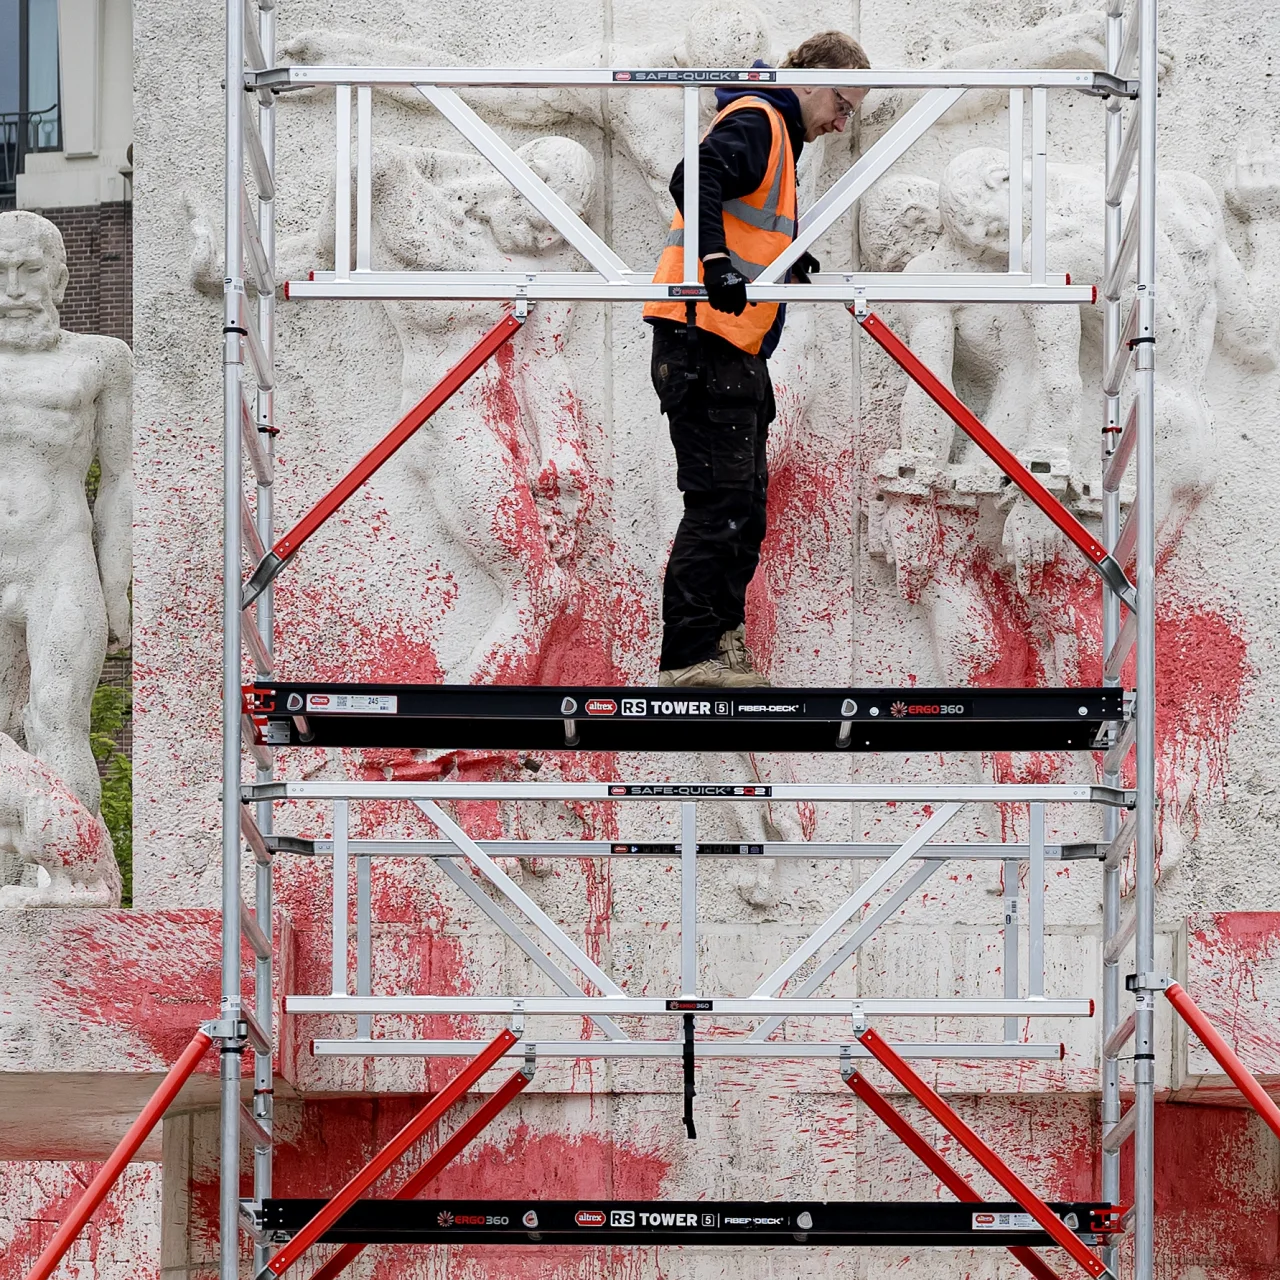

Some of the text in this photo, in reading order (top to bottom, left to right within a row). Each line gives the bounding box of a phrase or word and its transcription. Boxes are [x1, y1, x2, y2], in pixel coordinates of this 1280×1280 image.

[738, 72, 770, 81] SQ2
[588, 700, 613, 711] altrex
[623, 699, 646, 714] RS
[650, 701, 711, 715] TOWER
[717, 702, 726, 713] 5
[907, 704, 965, 715] ERGO360
[734, 786, 766, 796] SQ2
[454, 1215, 510, 1226] ERGO360
[578, 1213, 603, 1223] altrex
[612, 1211, 635, 1226] RS
[639, 1213, 698, 1226] TOWER
[704, 1215, 713, 1226] 5
